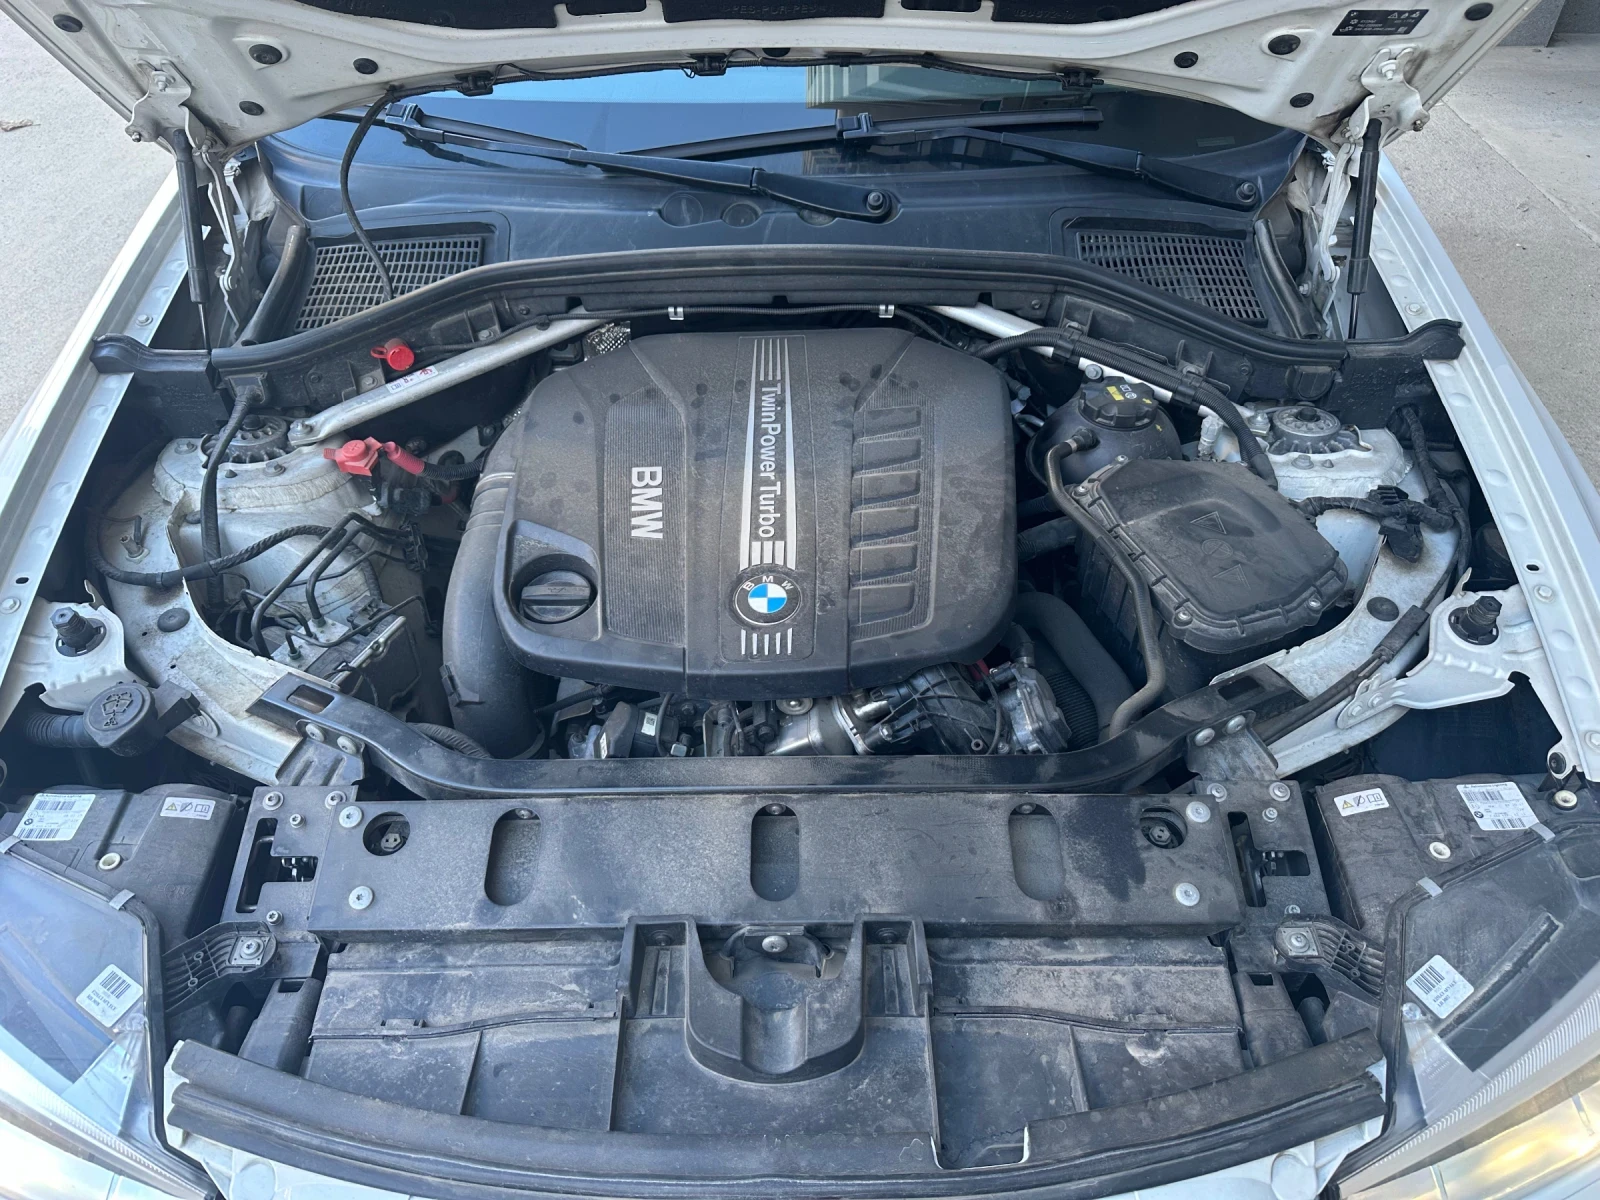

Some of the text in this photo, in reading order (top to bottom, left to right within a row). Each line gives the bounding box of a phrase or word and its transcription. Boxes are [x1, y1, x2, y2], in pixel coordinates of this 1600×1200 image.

[758, 382, 782, 538] TwinPower Turbo
[631, 466, 663, 539] BMW
[743, 575, 794, 591] BMW
